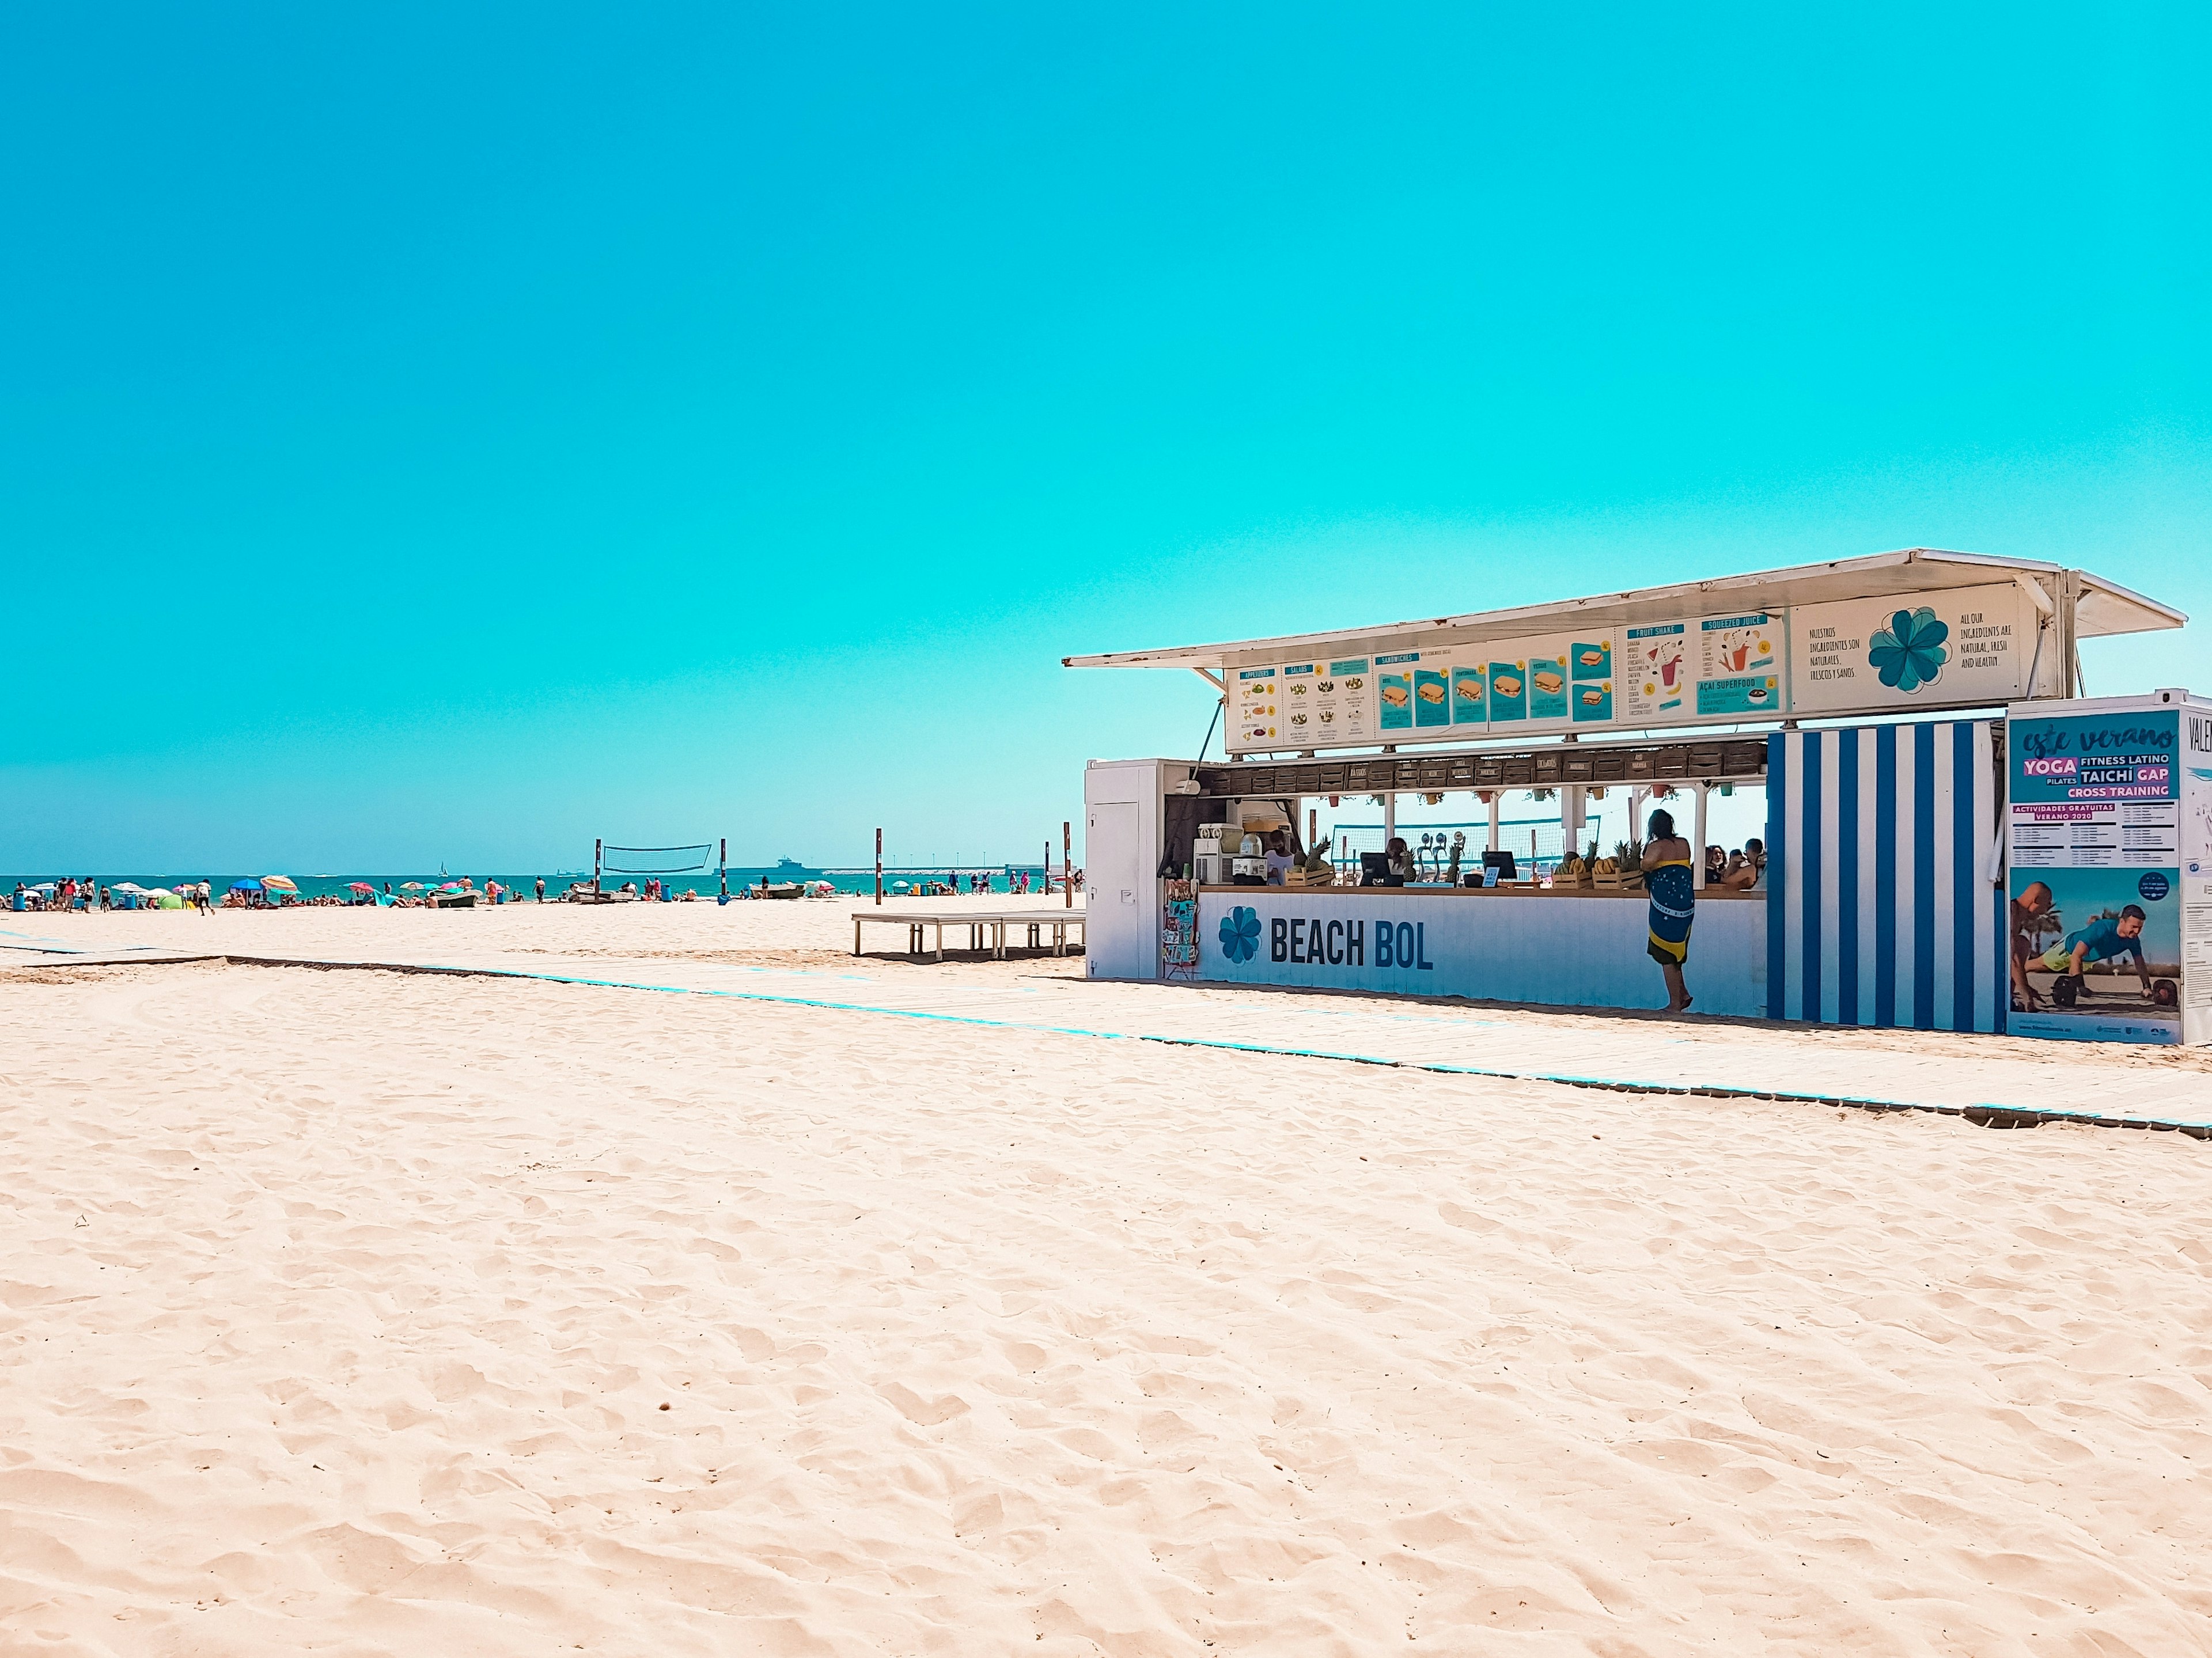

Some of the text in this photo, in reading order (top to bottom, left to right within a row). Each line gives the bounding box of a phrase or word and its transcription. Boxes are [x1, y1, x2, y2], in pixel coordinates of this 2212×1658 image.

[1708, 615, 1760, 629] SQUEEZED JUICE
[1960, 613, 1983, 624] ALL OUR
[1636, 625, 1675, 637] FRUIT SHAKE
[1809, 627, 1835, 639] NUESTROS
[1960, 624, 2012, 639] INGREDIENTS ARE
[1810, 639, 1859, 652] INGREDIENTES SON
[1961, 640, 2007, 654] NATURAL, FRESH
[1381, 654, 1412, 664] SANDWICHES
[1961, 658, 1974, 668] AND
[1245, 670, 1269, 678] APPETIZERS
[1290, 666, 1308, 674] SALADS
[1810, 669, 1832, 680] FRESCOS
[1832, 669, 1835, 678] Y
[1717, 678, 1755, 689] SUPERFOOD
[2022, 724, 2176, 760] este verano
[2081, 754, 2169, 766] FITNESS LATINO
[2024, 759, 2077, 775] YOGA
[2081, 767, 2133, 783] TAICHÍ
[2137, 768, 2169, 780] GAP
[2068, 786, 2169, 798] CROSS TRAINING
[1271, 918, 1433, 970] BEACH BOL
